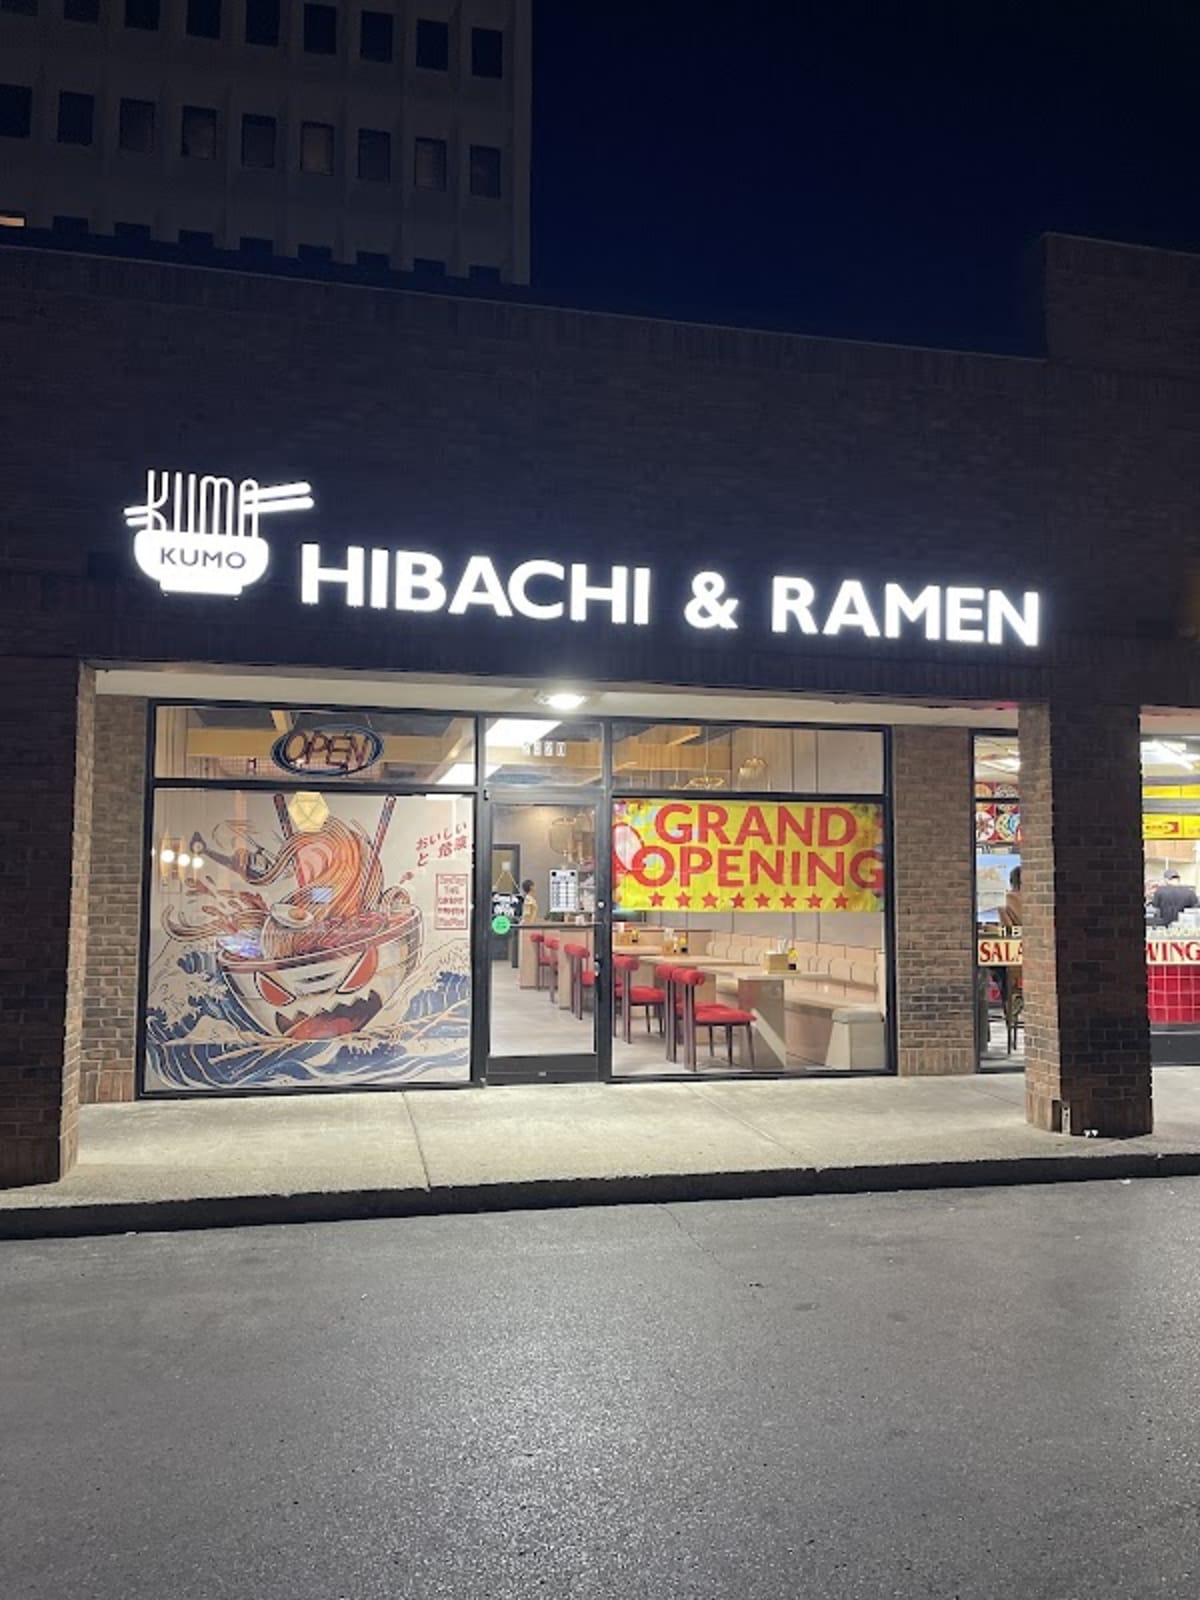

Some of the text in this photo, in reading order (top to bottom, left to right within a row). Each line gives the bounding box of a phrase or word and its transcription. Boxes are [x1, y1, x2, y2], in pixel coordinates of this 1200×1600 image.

[160, 547, 246, 570] KUMO
[301, 543, 1039, 647] HIBACHI & RAMEN
[284, 730, 370, 768] OPEN
[654, 803, 858, 847] GRAND
[631, 846, 884, 889] OPENING
